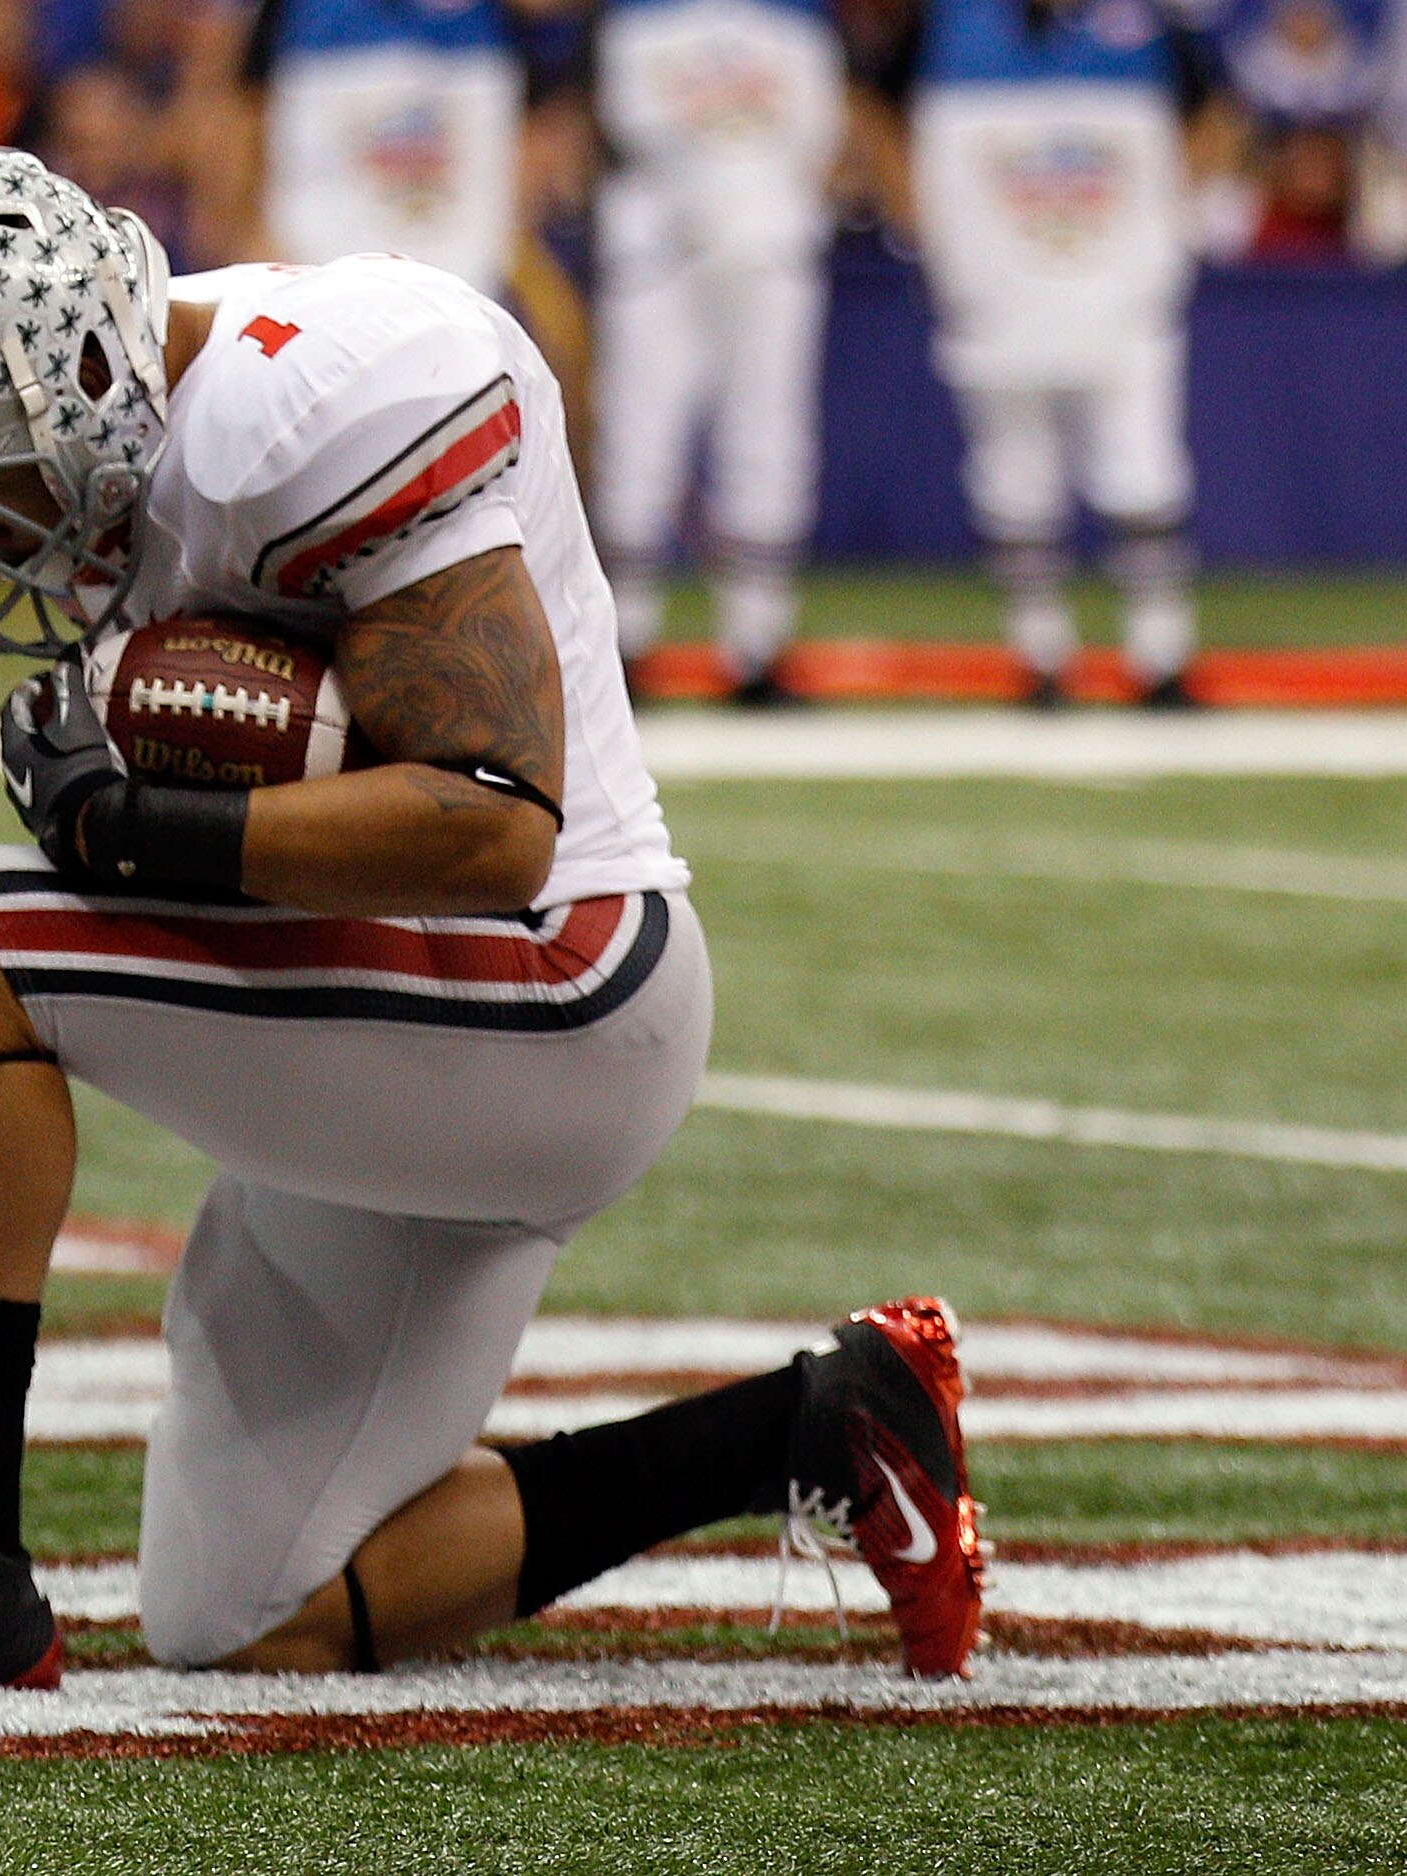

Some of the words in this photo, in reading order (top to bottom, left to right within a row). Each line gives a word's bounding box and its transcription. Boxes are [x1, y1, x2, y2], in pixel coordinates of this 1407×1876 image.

[238, 314, 303, 359] 1
[163, 636, 294, 681] Wilson
[132, 735, 266, 786] Wilson
